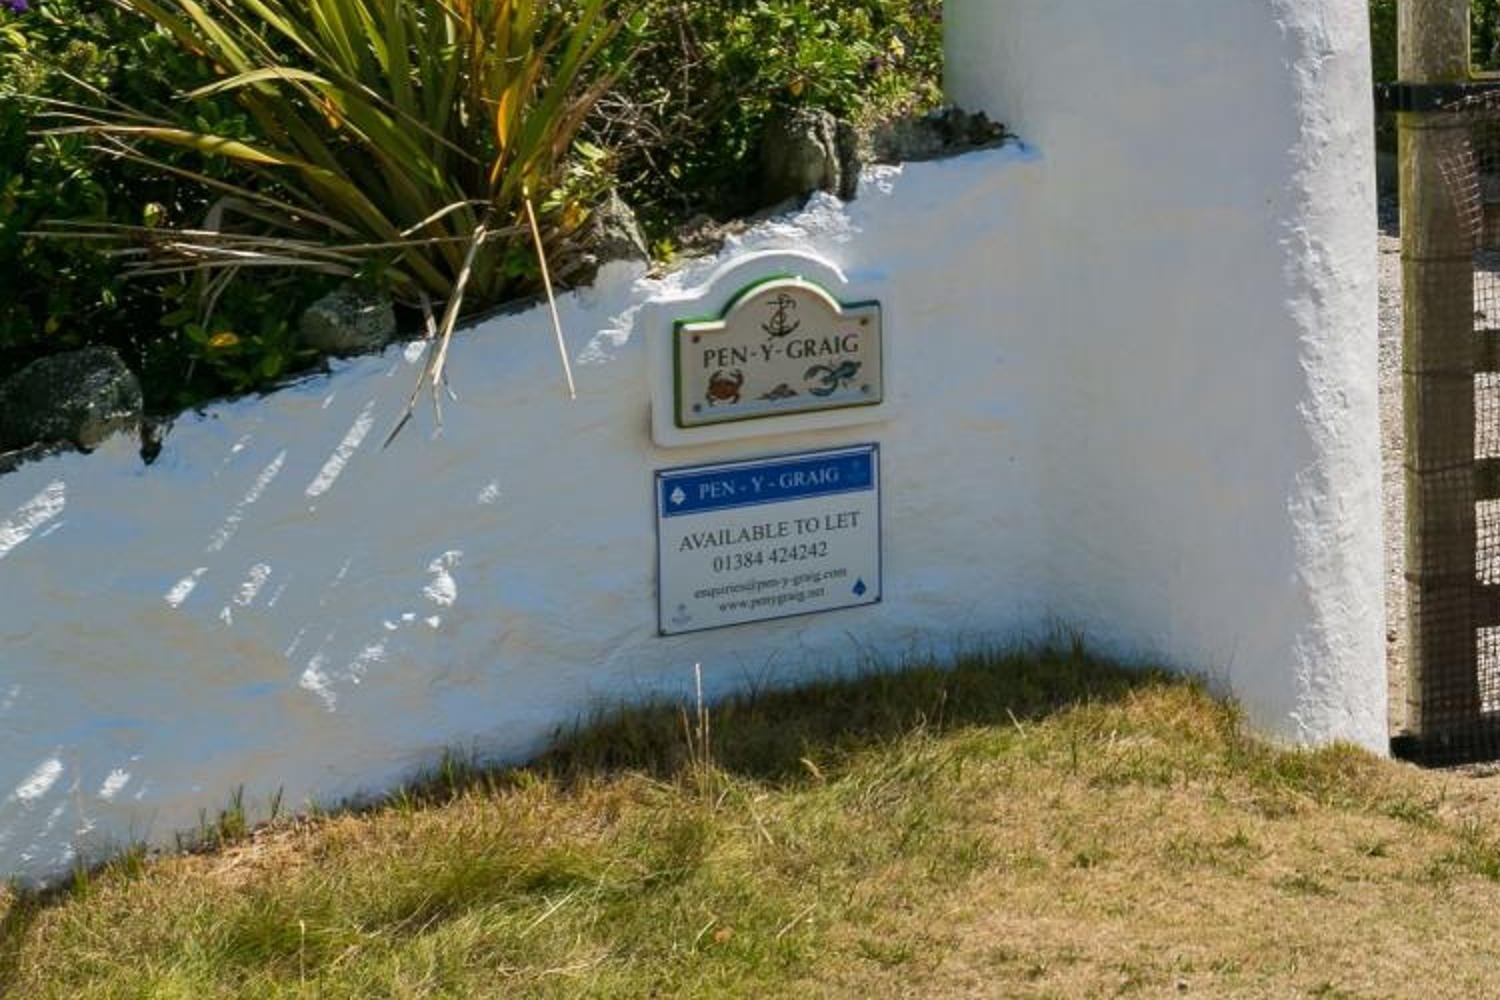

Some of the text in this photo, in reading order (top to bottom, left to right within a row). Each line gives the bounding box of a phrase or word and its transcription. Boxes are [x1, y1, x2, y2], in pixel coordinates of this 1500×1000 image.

[679, 511, 861, 552] AVAILABLE TO LET
[713, 541, 828, 573] 01384 424242
